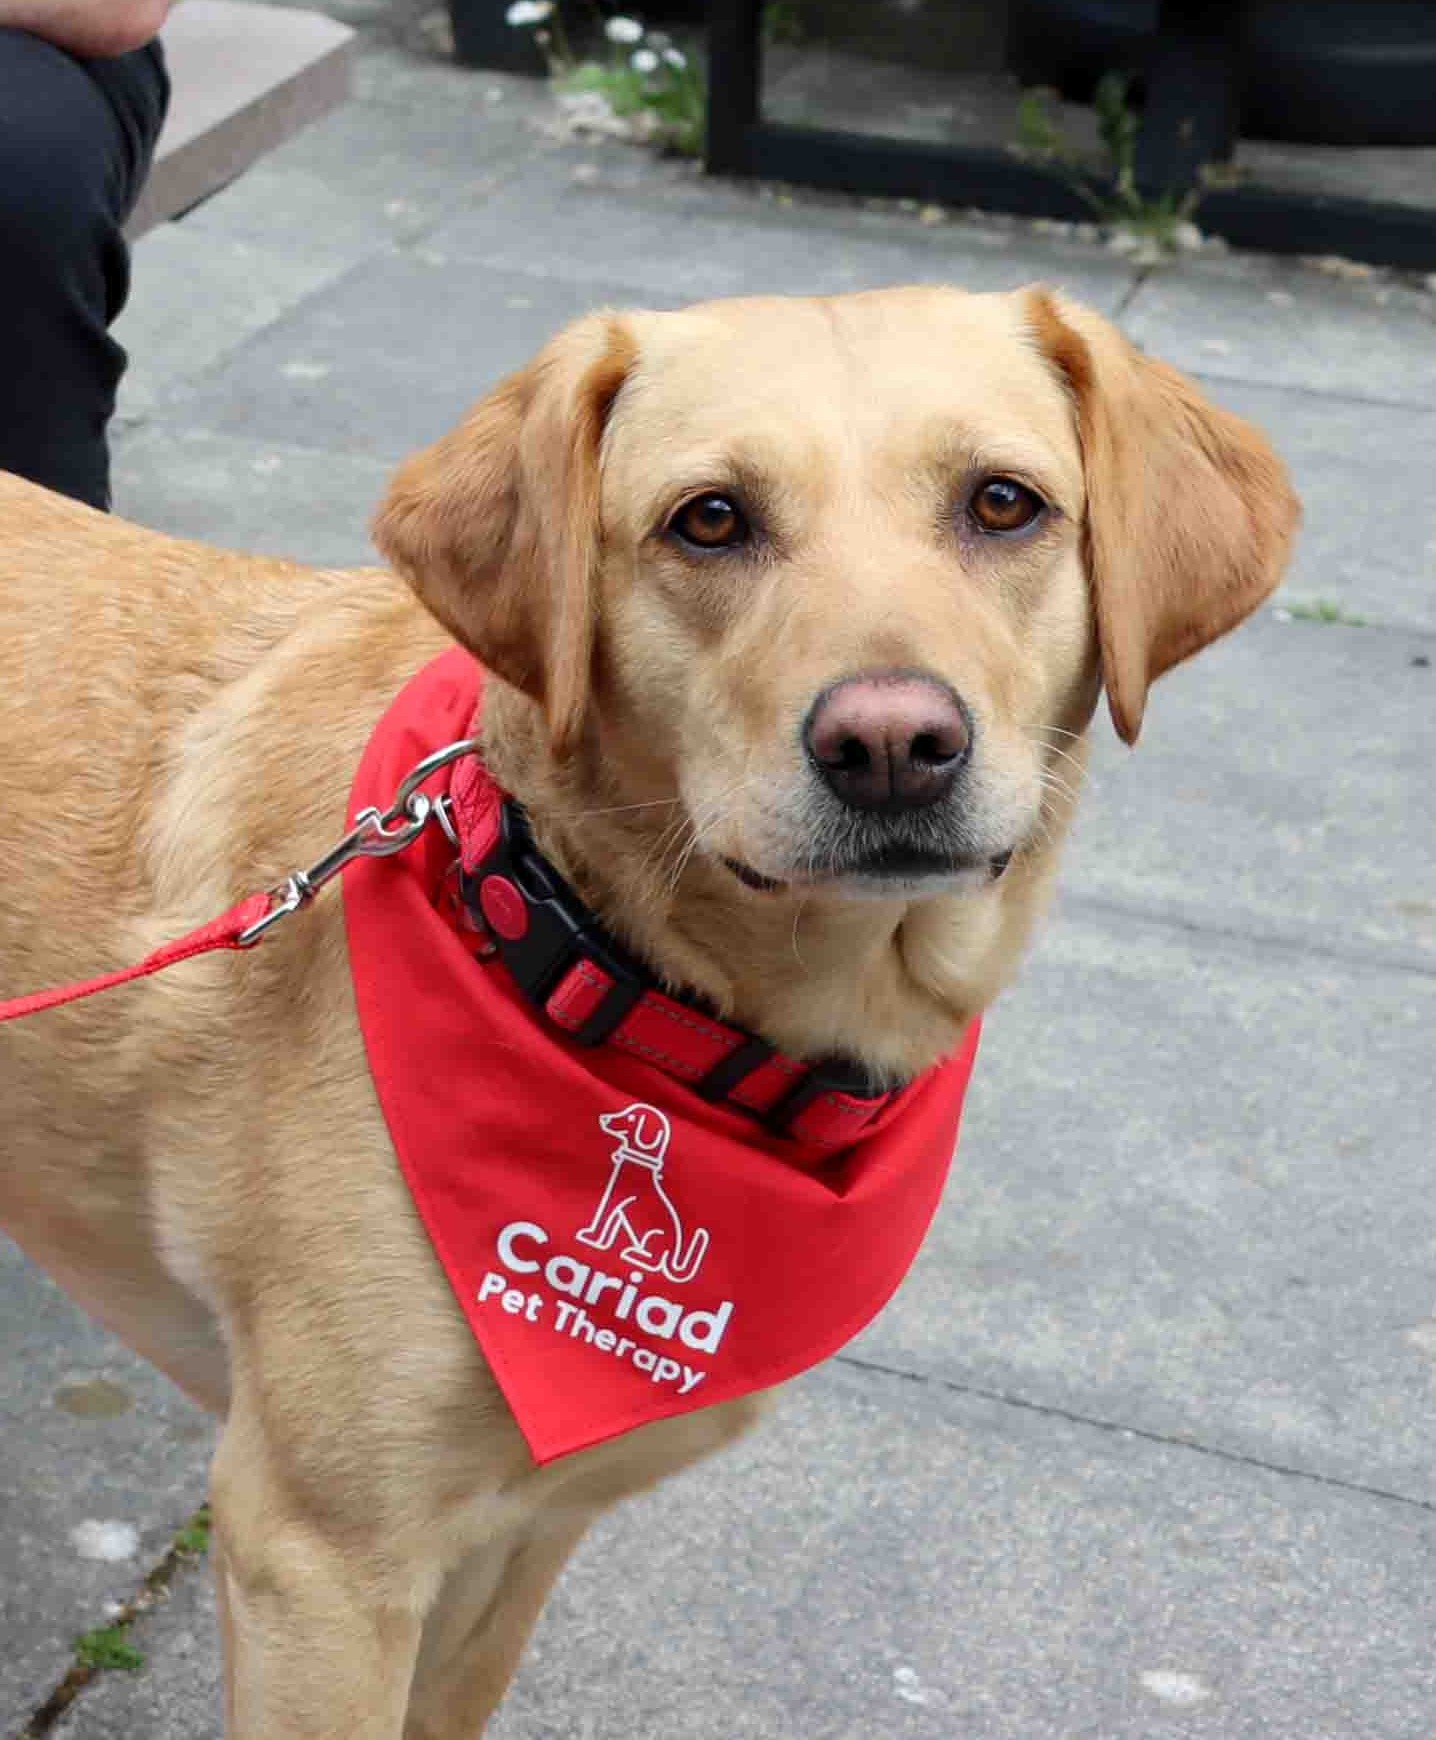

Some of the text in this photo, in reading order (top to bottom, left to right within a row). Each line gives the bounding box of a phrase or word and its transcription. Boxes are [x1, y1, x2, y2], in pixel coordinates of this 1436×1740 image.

[476, 1271, 706, 1394] Pet Therapy
[496, 1220, 735, 1355] Cariad
